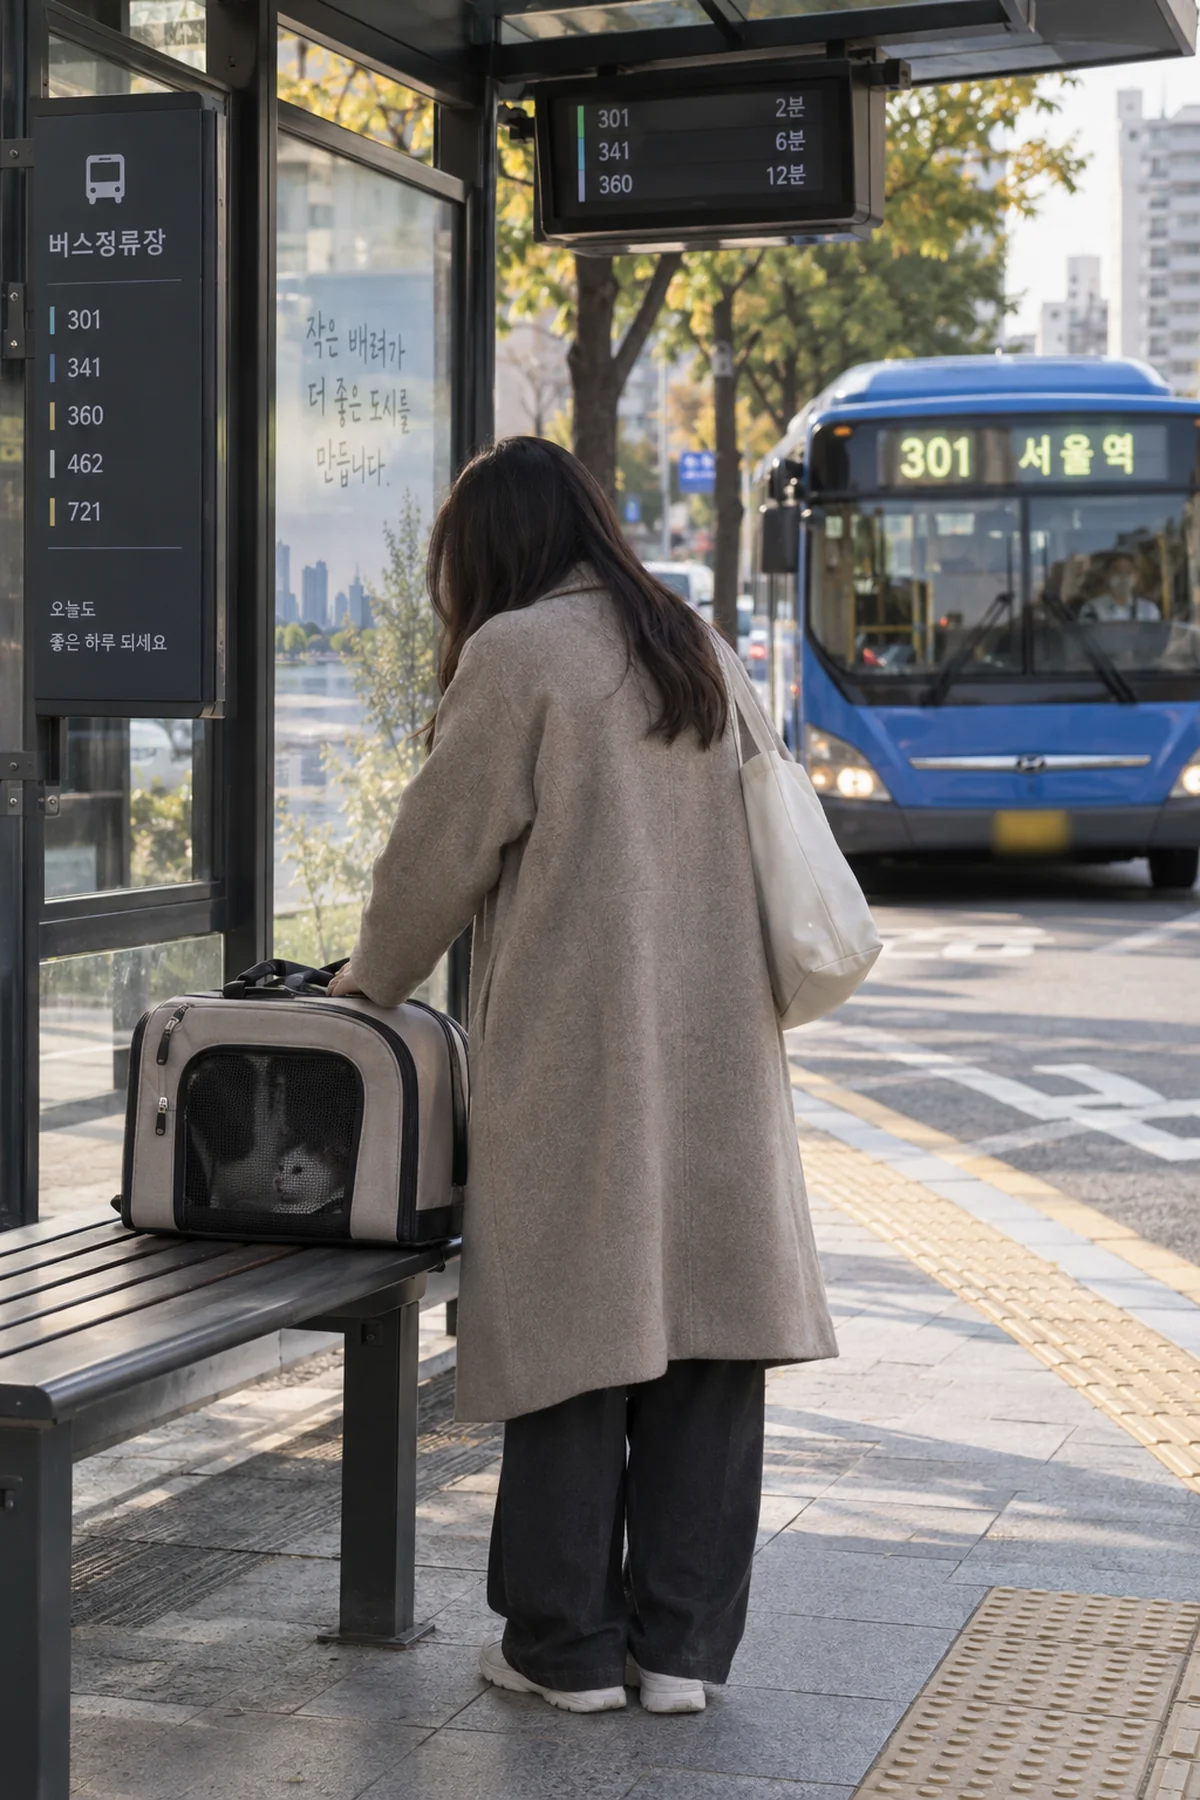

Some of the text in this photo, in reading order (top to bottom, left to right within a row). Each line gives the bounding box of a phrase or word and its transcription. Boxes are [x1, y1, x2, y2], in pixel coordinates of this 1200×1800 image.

[598, 95, 806, 129] 301 2분
[598, 129, 806, 162] 341 6분
[599, 163, 807, 195] 360 12분
[49, 228, 166, 258] 버스정류장
[67, 308, 101, 330] 301
[306, 310, 406, 371] 작은 배려가
[67, 357, 101, 378] 341
[67, 405, 104, 426] 360
[307, 376, 412, 434] 더 좋은 도시를
[67, 453, 104, 474] 462
[316, 439, 390, 488] 만듭니다.
[900, 436, 970, 478] 301
[67, 501, 101, 522] 721
[49, 600, 96, 619] 오늘도
[49, 632, 168, 653] 좋은 하루 되세요
